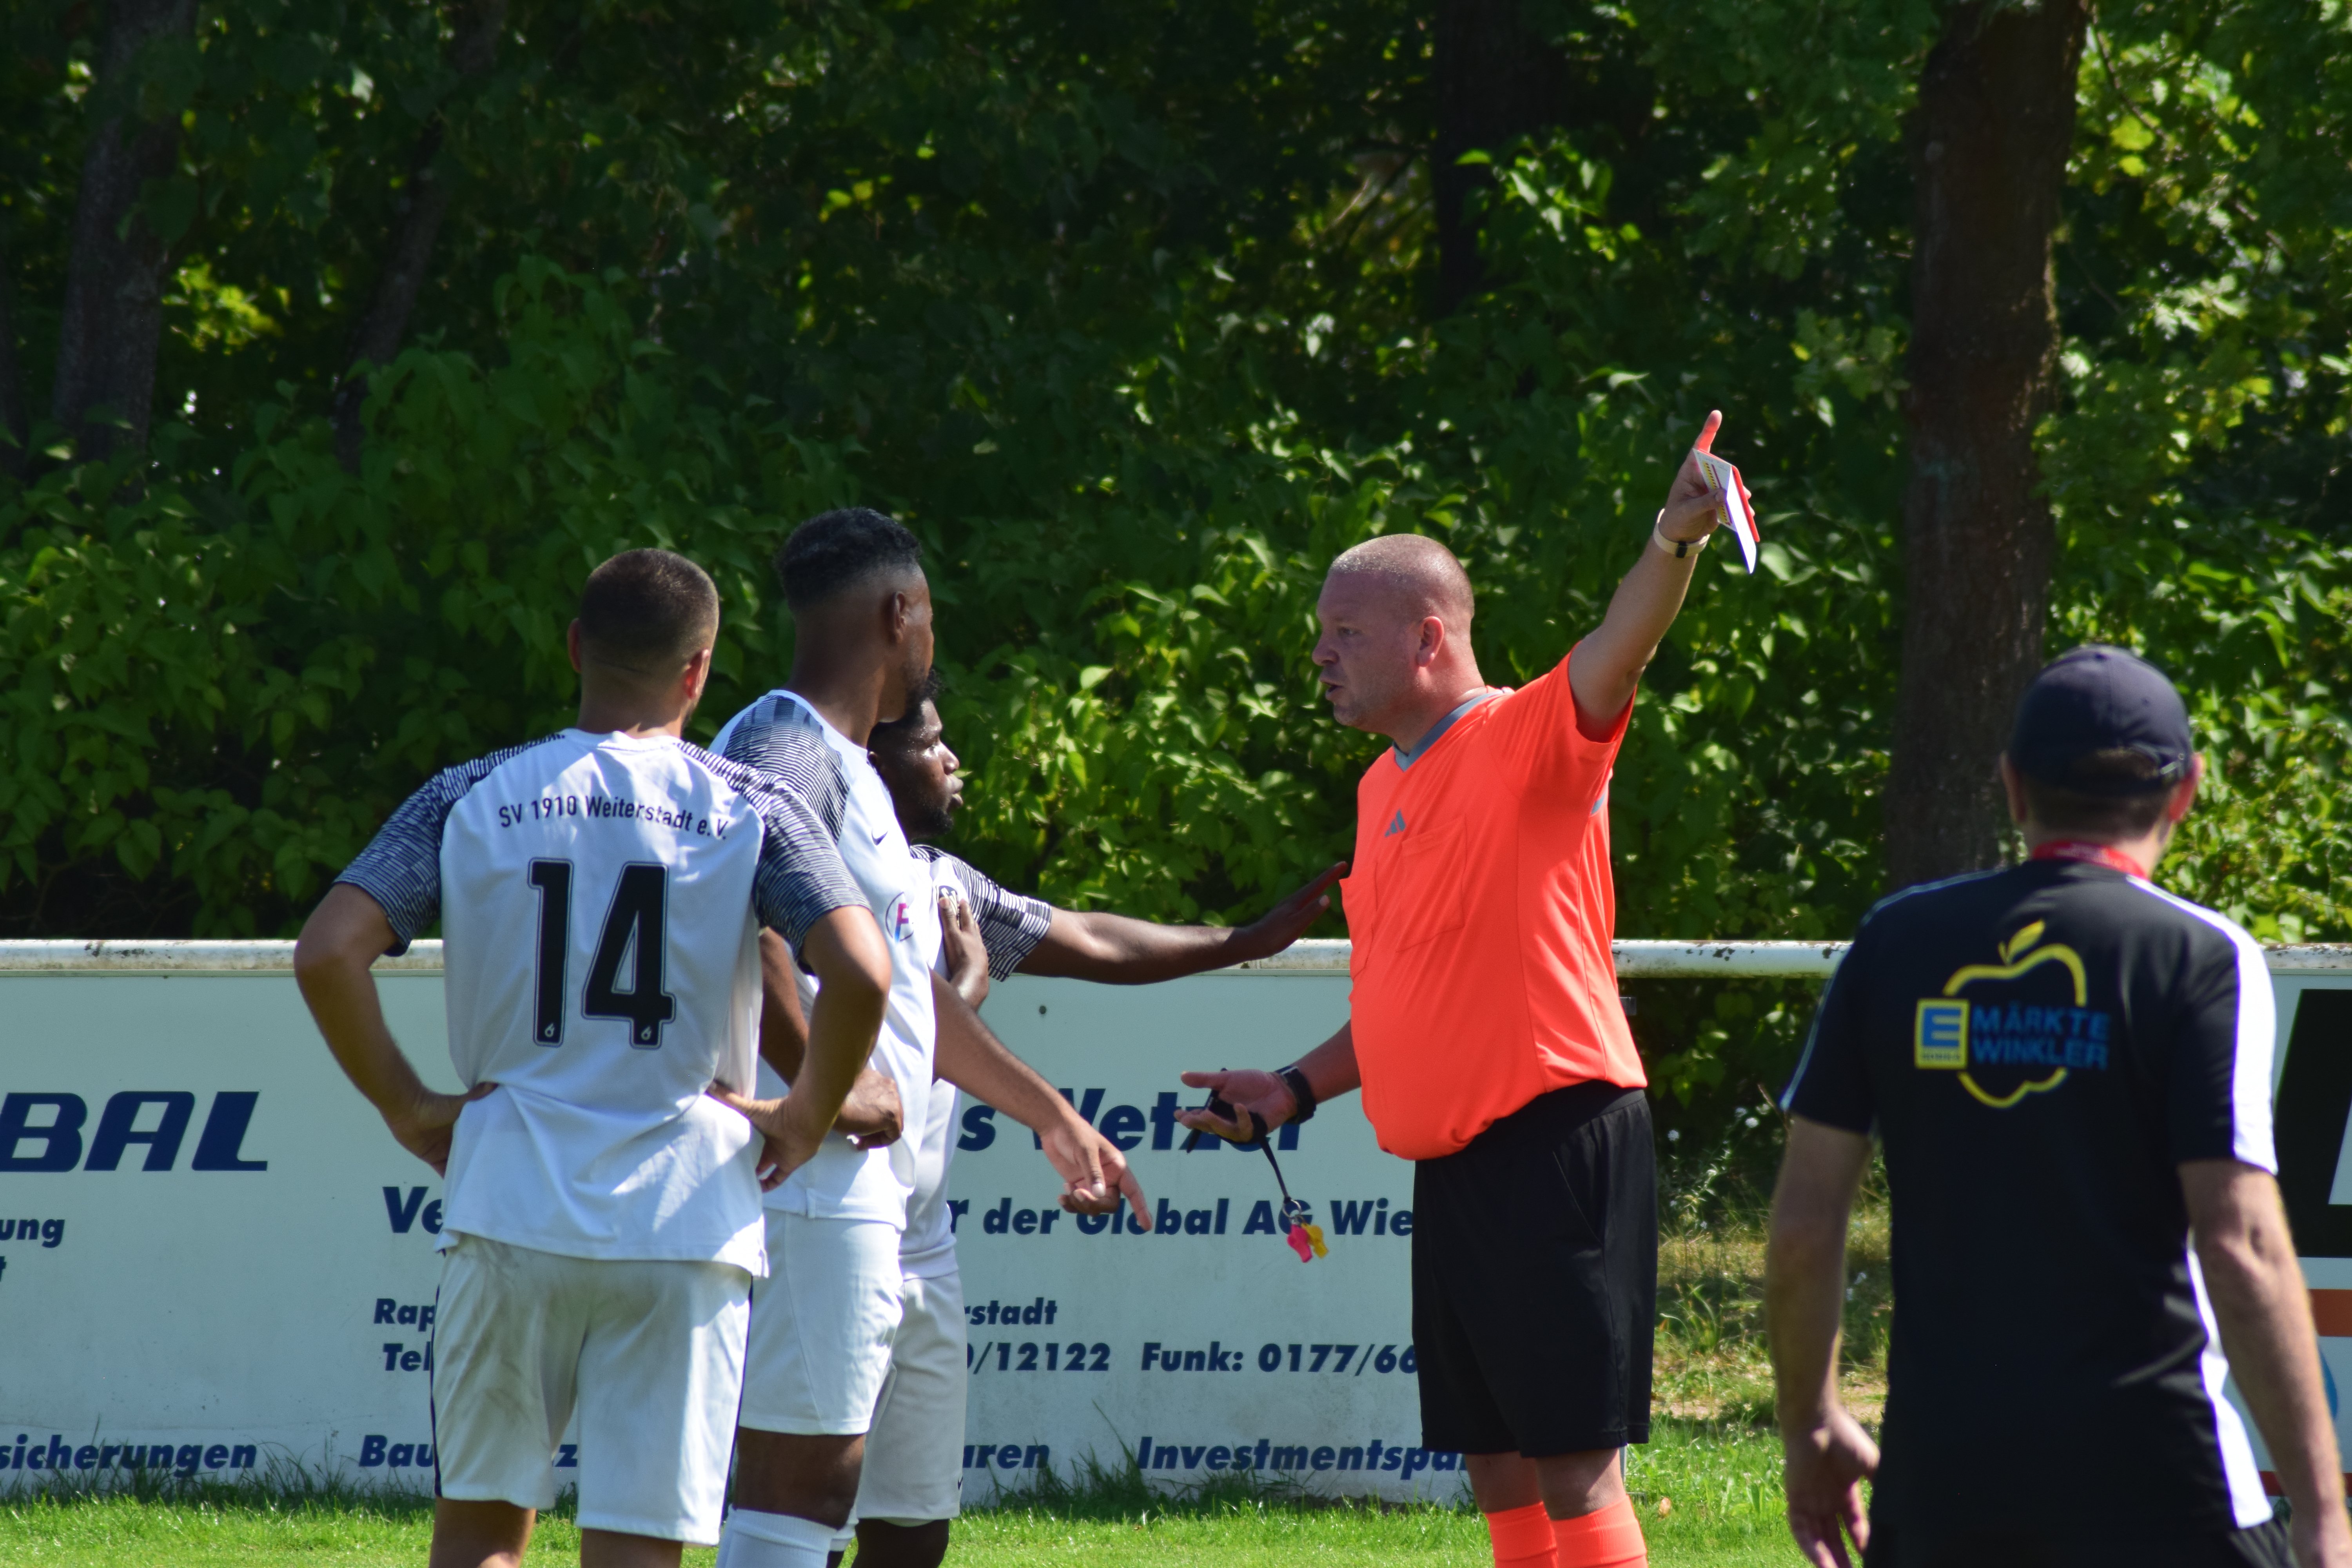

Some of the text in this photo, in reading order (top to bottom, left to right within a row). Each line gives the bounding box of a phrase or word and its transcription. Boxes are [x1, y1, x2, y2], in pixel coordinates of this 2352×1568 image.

[499, 804, 522, 828] SV
[531, 795, 577, 820] 1910
[585, 795, 693, 831] Weiterstadt
[528, 857, 677, 1050] 14
[1971, 1036, 2108, 1071] WINKLER
[0, 1091, 269, 1173] BAL
[983, 1197, 1060, 1235] der
[1076, 1198, 1229, 1235] Global
[1242, 1200, 1313, 1235] AG
[1330, 1198, 1413, 1236] Wie
[1141, 1341, 1244, 1372] Funk:
